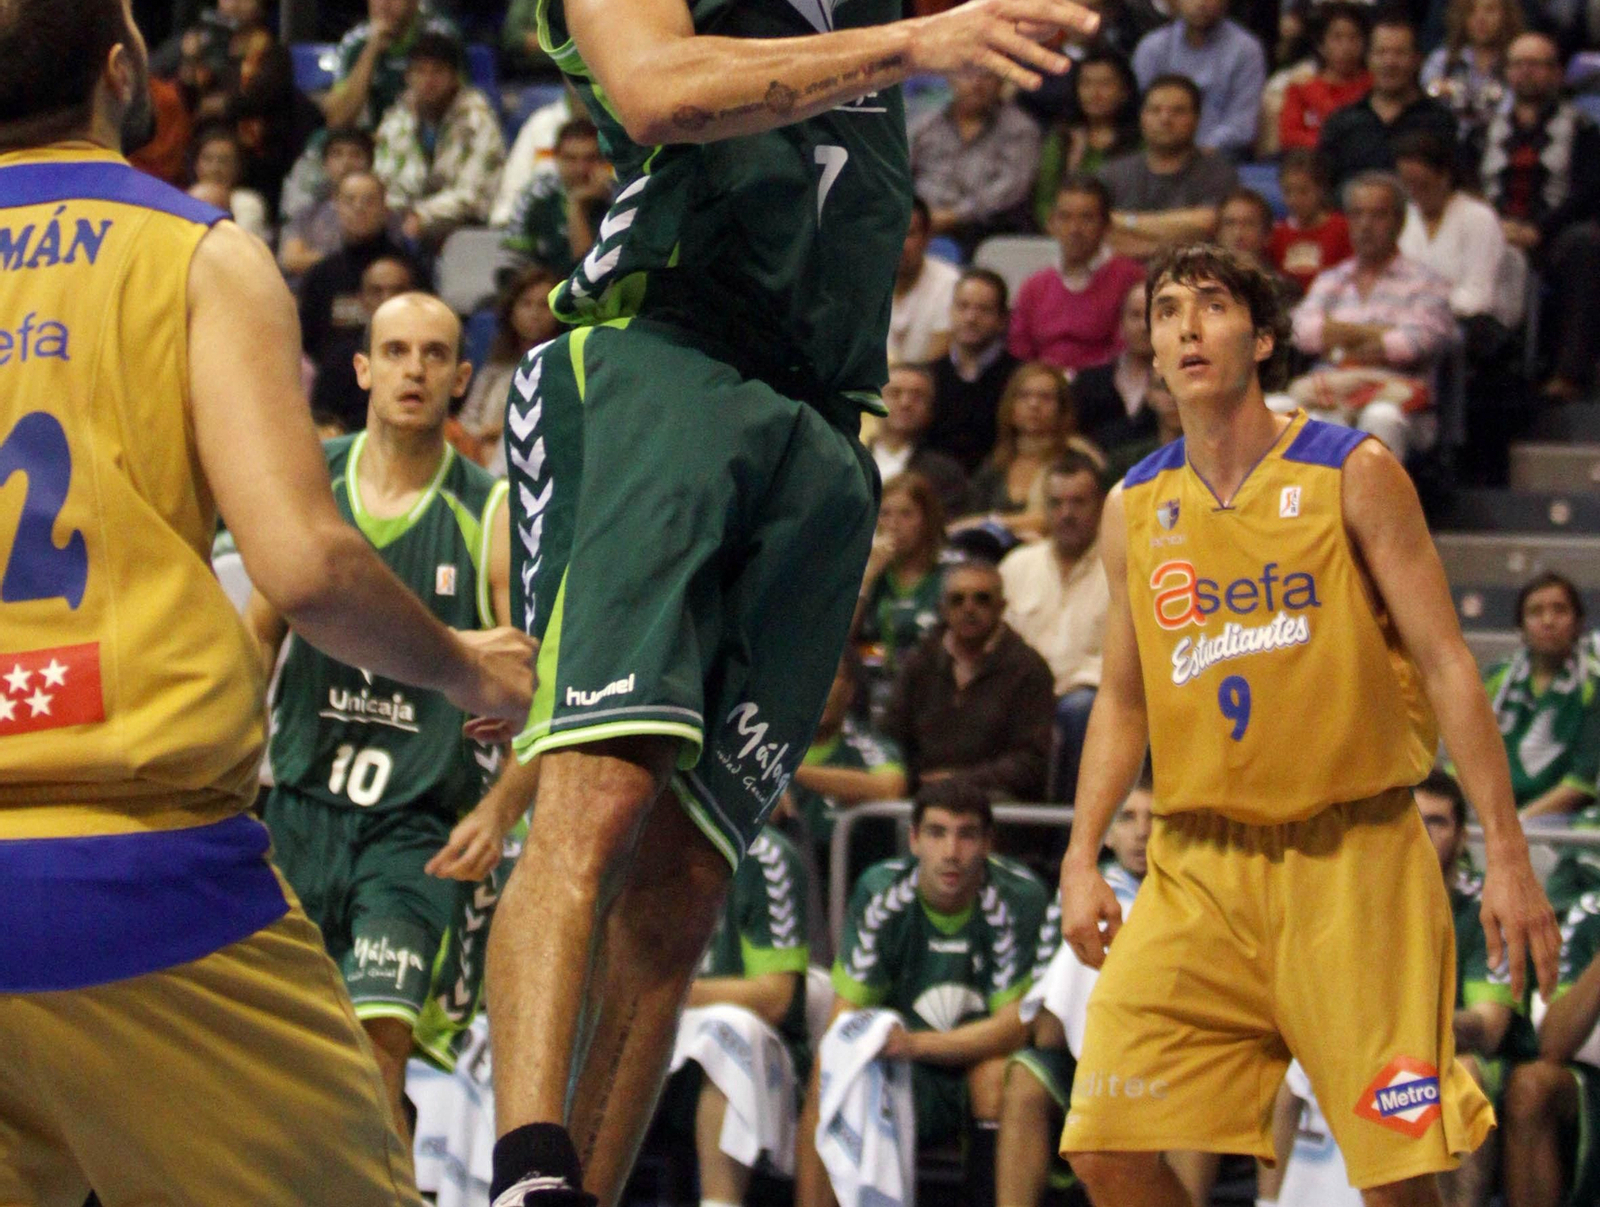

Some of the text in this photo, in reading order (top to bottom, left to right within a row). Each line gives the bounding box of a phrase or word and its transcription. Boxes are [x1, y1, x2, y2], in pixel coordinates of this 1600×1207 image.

[814, 145, 848, 230] 7
[0, 411, 88, 610] 2
[1150, 559, 1322, 631] asefa
[1171, 611, 1310, 687] Estudiantes
[328, 687, 415, 724] Unicaja
[566, 673, 635, 706] hummel
[1218, 675, 1251, 742] 9
[328, 744, 392, 806] 10
[1380, 1085, 1437, 1111] Metro
